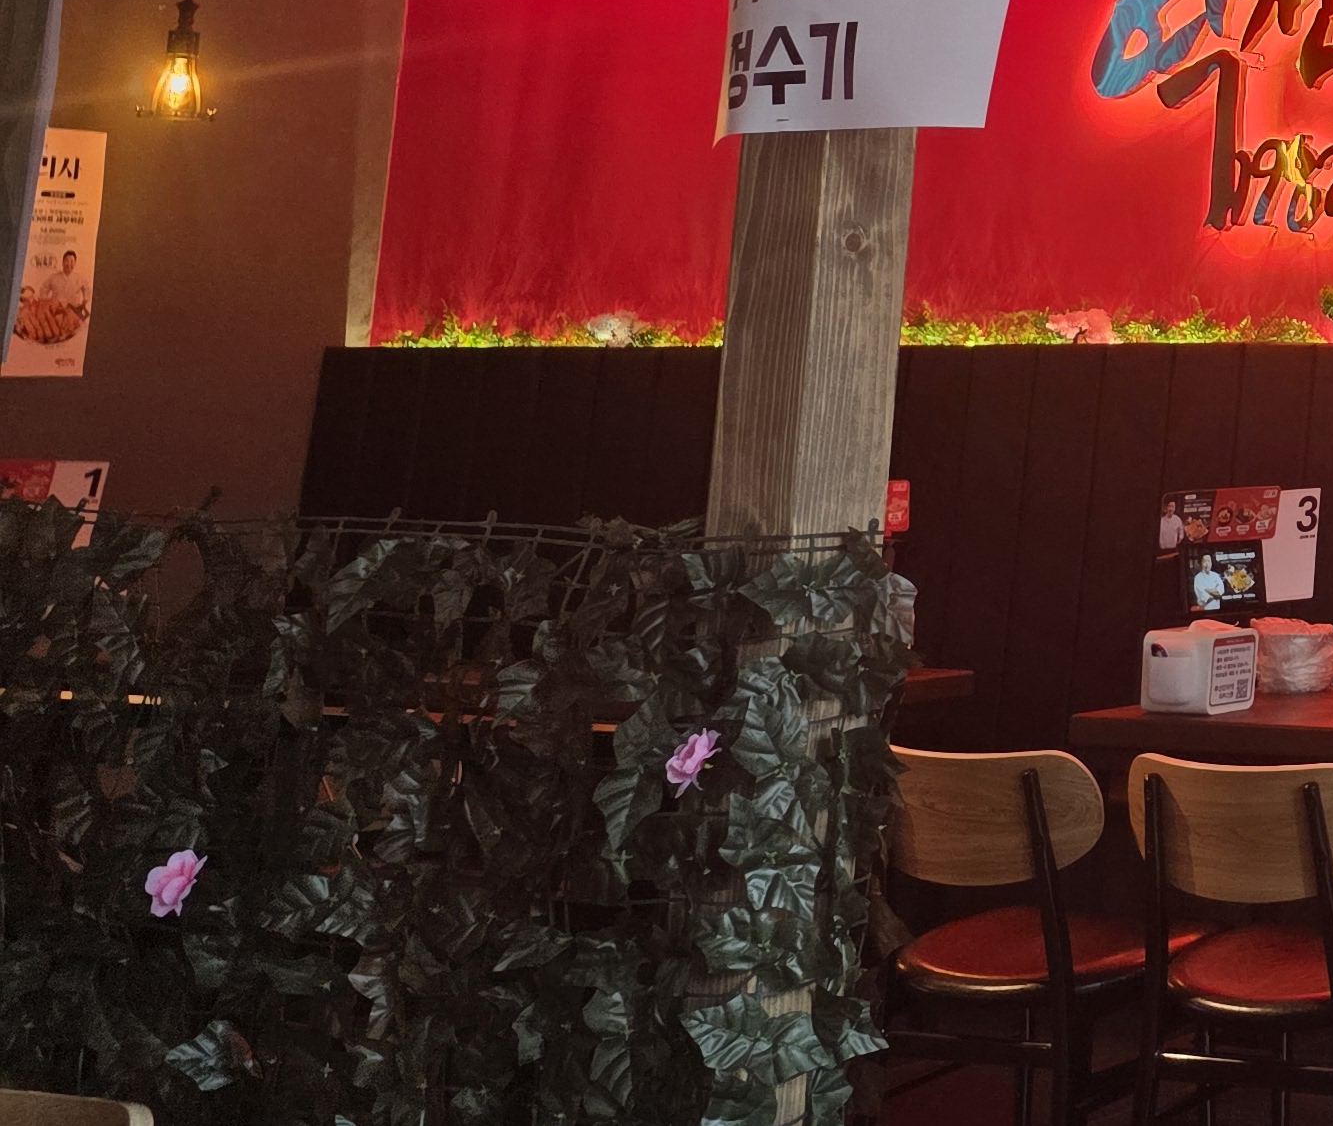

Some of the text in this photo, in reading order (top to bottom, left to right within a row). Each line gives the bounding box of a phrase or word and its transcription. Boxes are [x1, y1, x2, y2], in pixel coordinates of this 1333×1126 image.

[728, 21, 859, 110] 정수기
[84, 468, 103, 497] 1
[1296, 495, 1318, 533] 3
